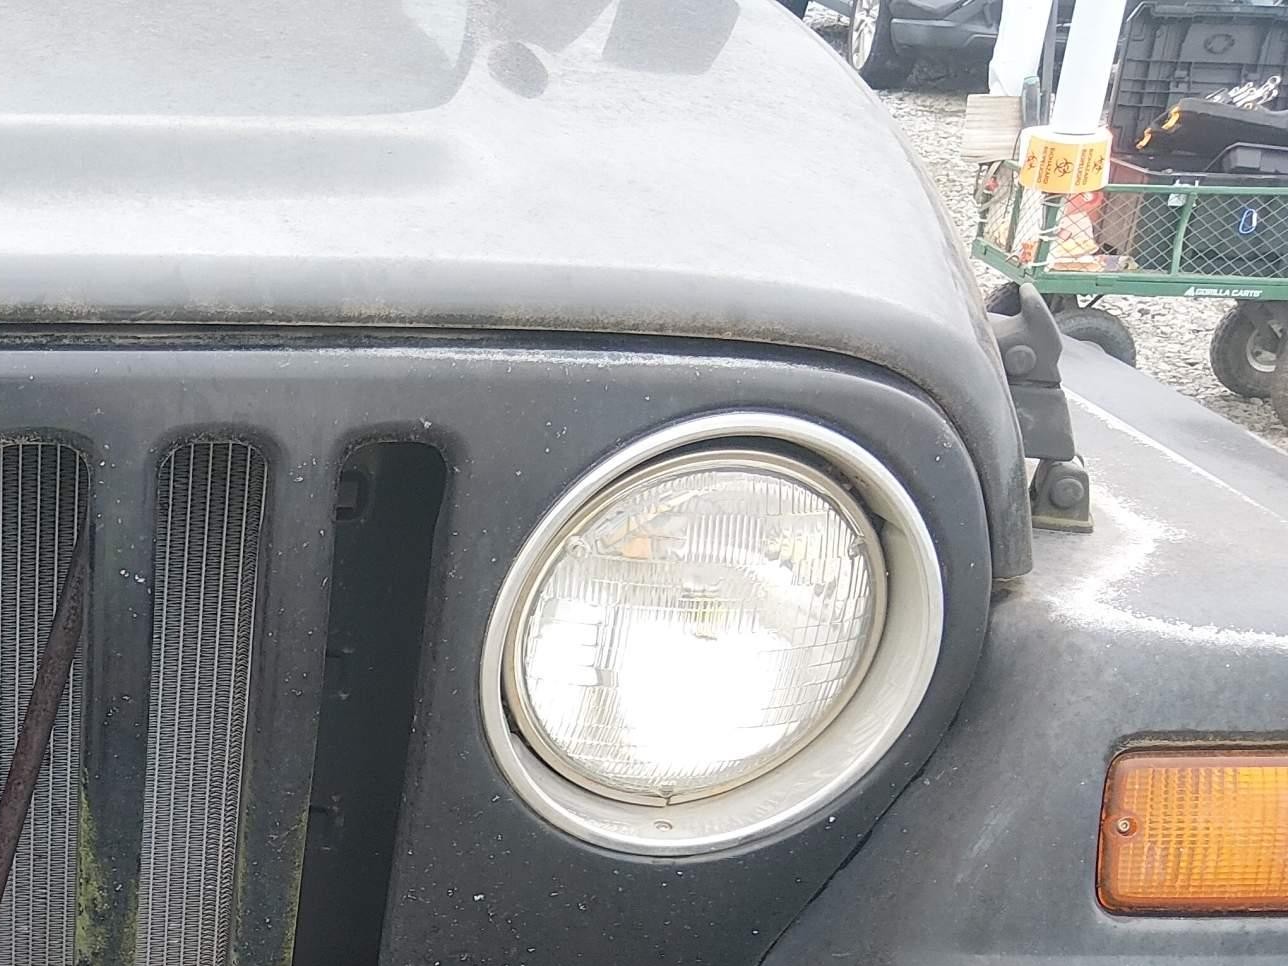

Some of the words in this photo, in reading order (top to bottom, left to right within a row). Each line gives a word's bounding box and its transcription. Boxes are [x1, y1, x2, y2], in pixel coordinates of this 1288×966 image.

[1043, 147, 1056, 184] BIOHAZARD
[1083, 148, 1094, 185] BIOHAZARD
[1195, 288, 1230, 296] GORILLA
